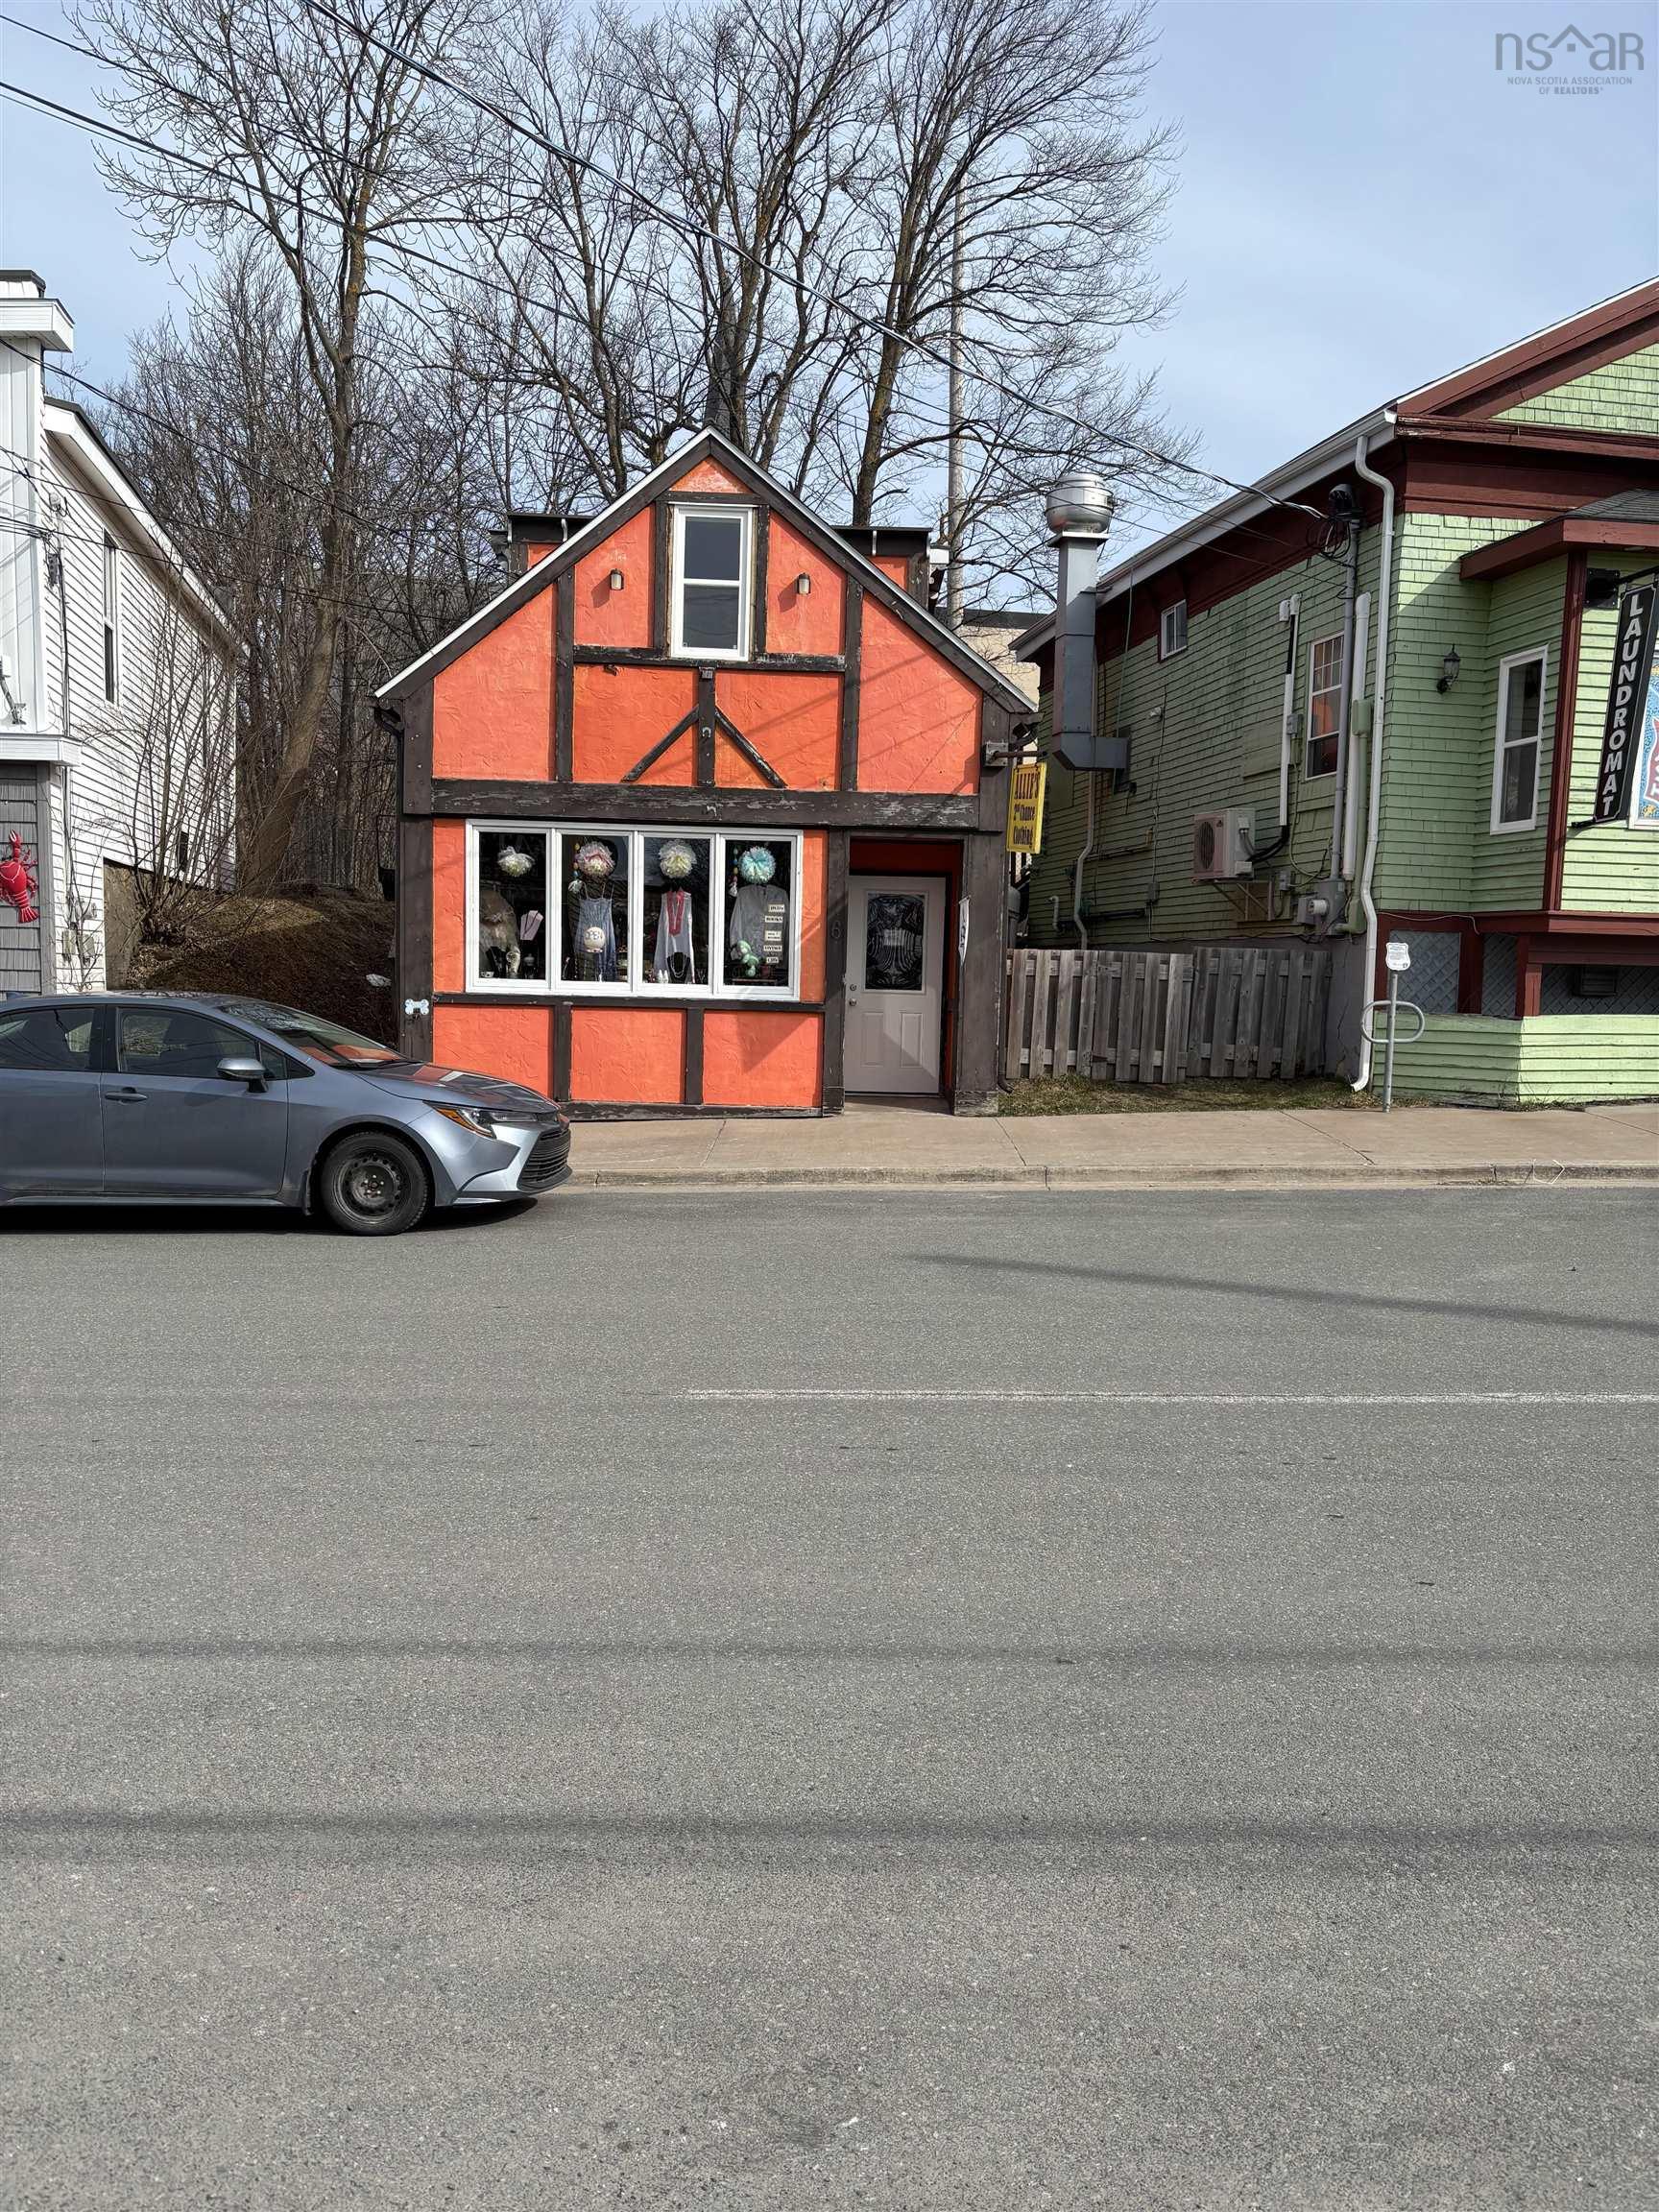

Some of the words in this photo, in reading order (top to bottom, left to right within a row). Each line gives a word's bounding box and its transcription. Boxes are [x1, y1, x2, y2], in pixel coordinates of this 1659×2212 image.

[1601, 594, 1643, 816] LAUNDROMAT
[1020, 805, 1036, 821] Chance
[1013, 826, 1034, 849] Clothing
